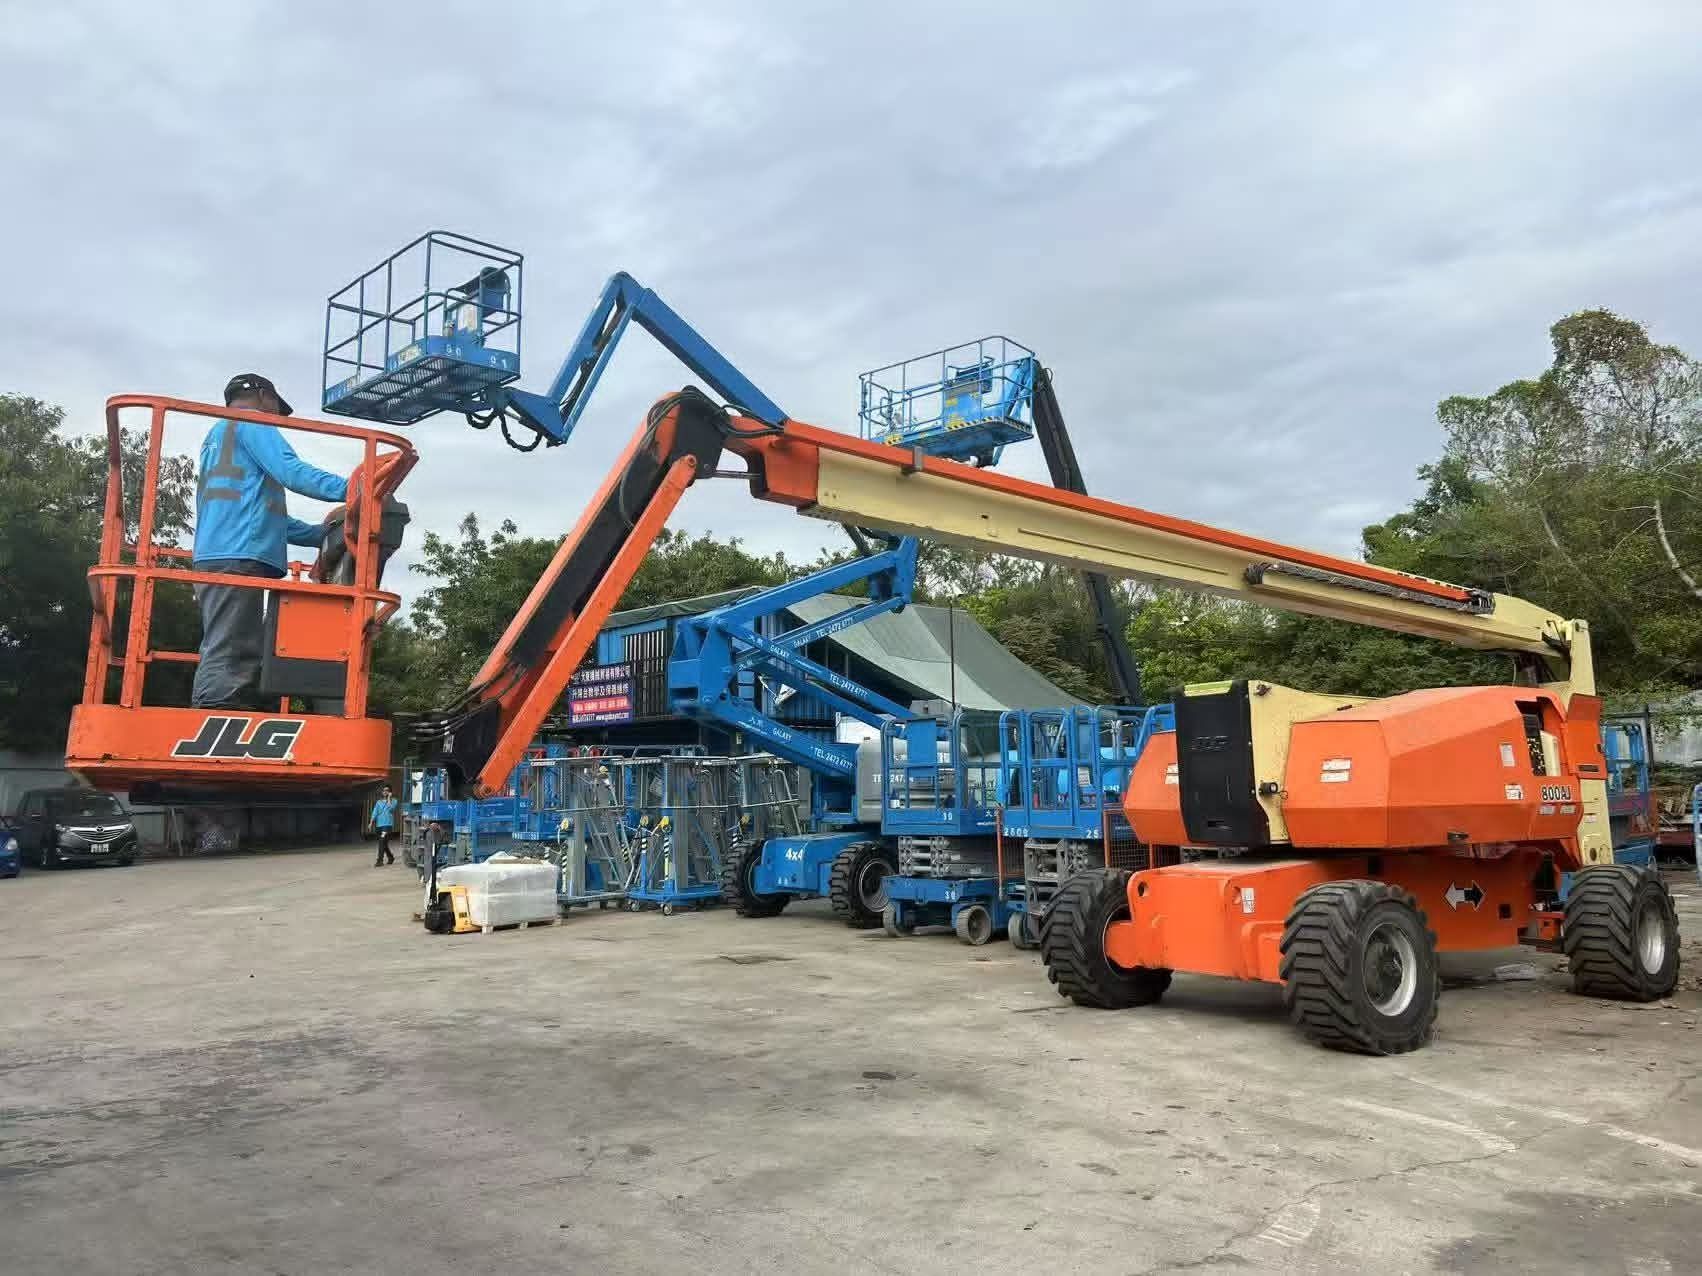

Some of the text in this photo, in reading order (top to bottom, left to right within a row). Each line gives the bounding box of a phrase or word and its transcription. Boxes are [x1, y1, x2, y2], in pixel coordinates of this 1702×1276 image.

[770, 644, 789, 659] GALAXY
[170, 715, 306, 761] JLG
[772, 727, 792, 741] GALAXY
[1541, 785, 1572, 801] 800AJ
[784, 847, 804, 861] 4x4
